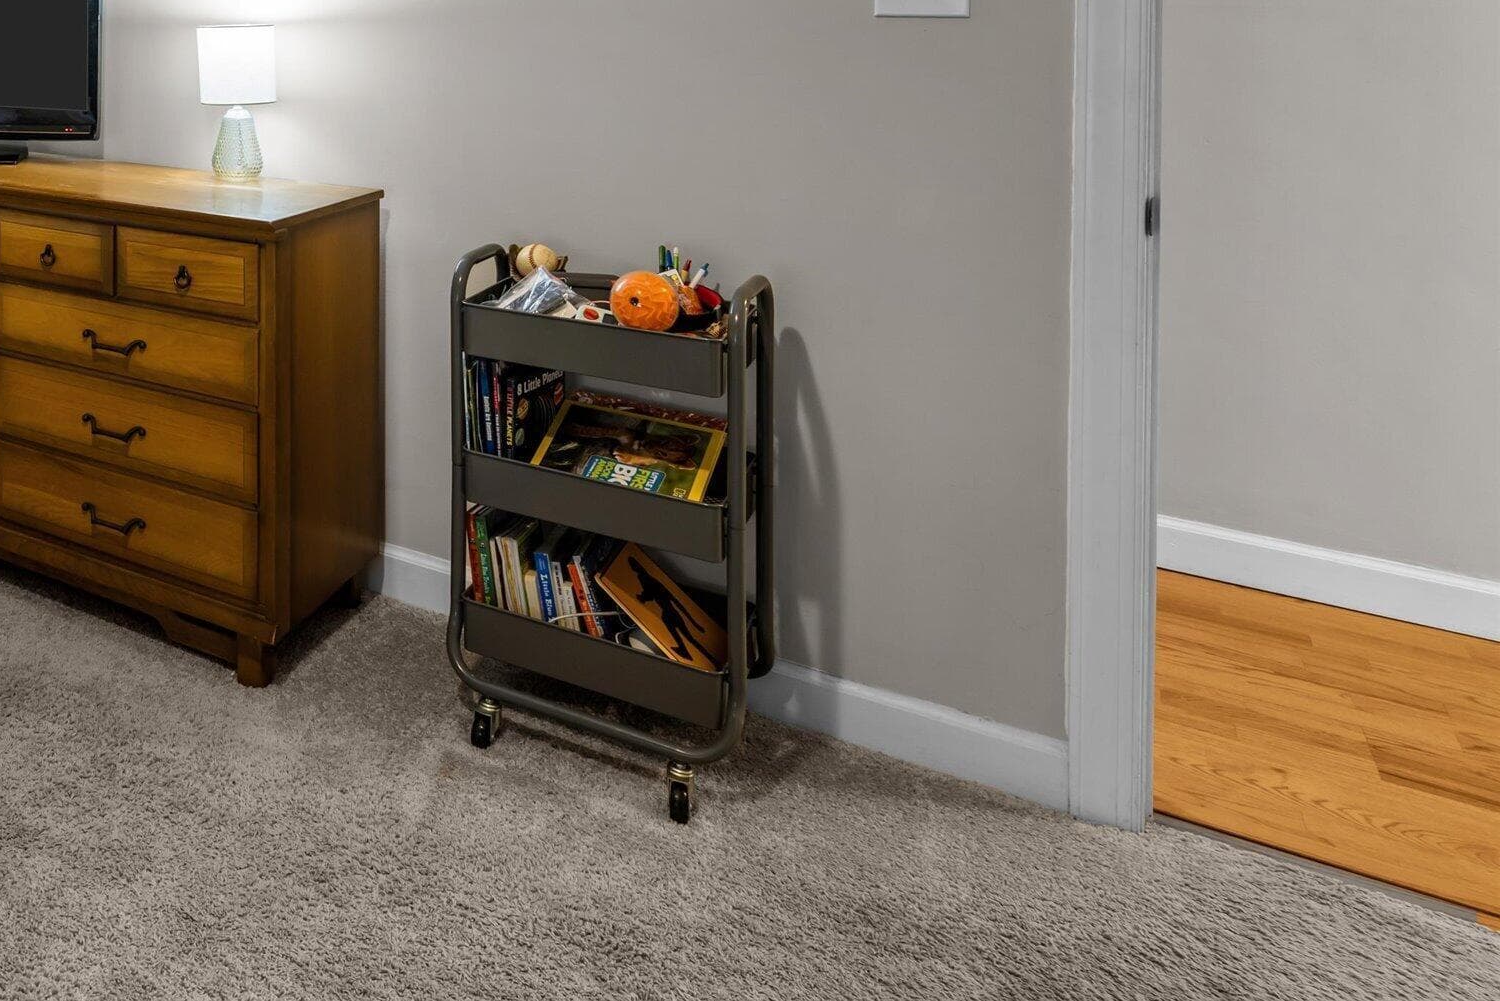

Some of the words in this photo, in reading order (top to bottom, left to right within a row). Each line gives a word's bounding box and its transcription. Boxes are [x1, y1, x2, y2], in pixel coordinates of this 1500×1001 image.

[517, 383, 523, 396] 8
[523, 376, 542, 394] Little
[506, 416, 514, 446] PLANETS
